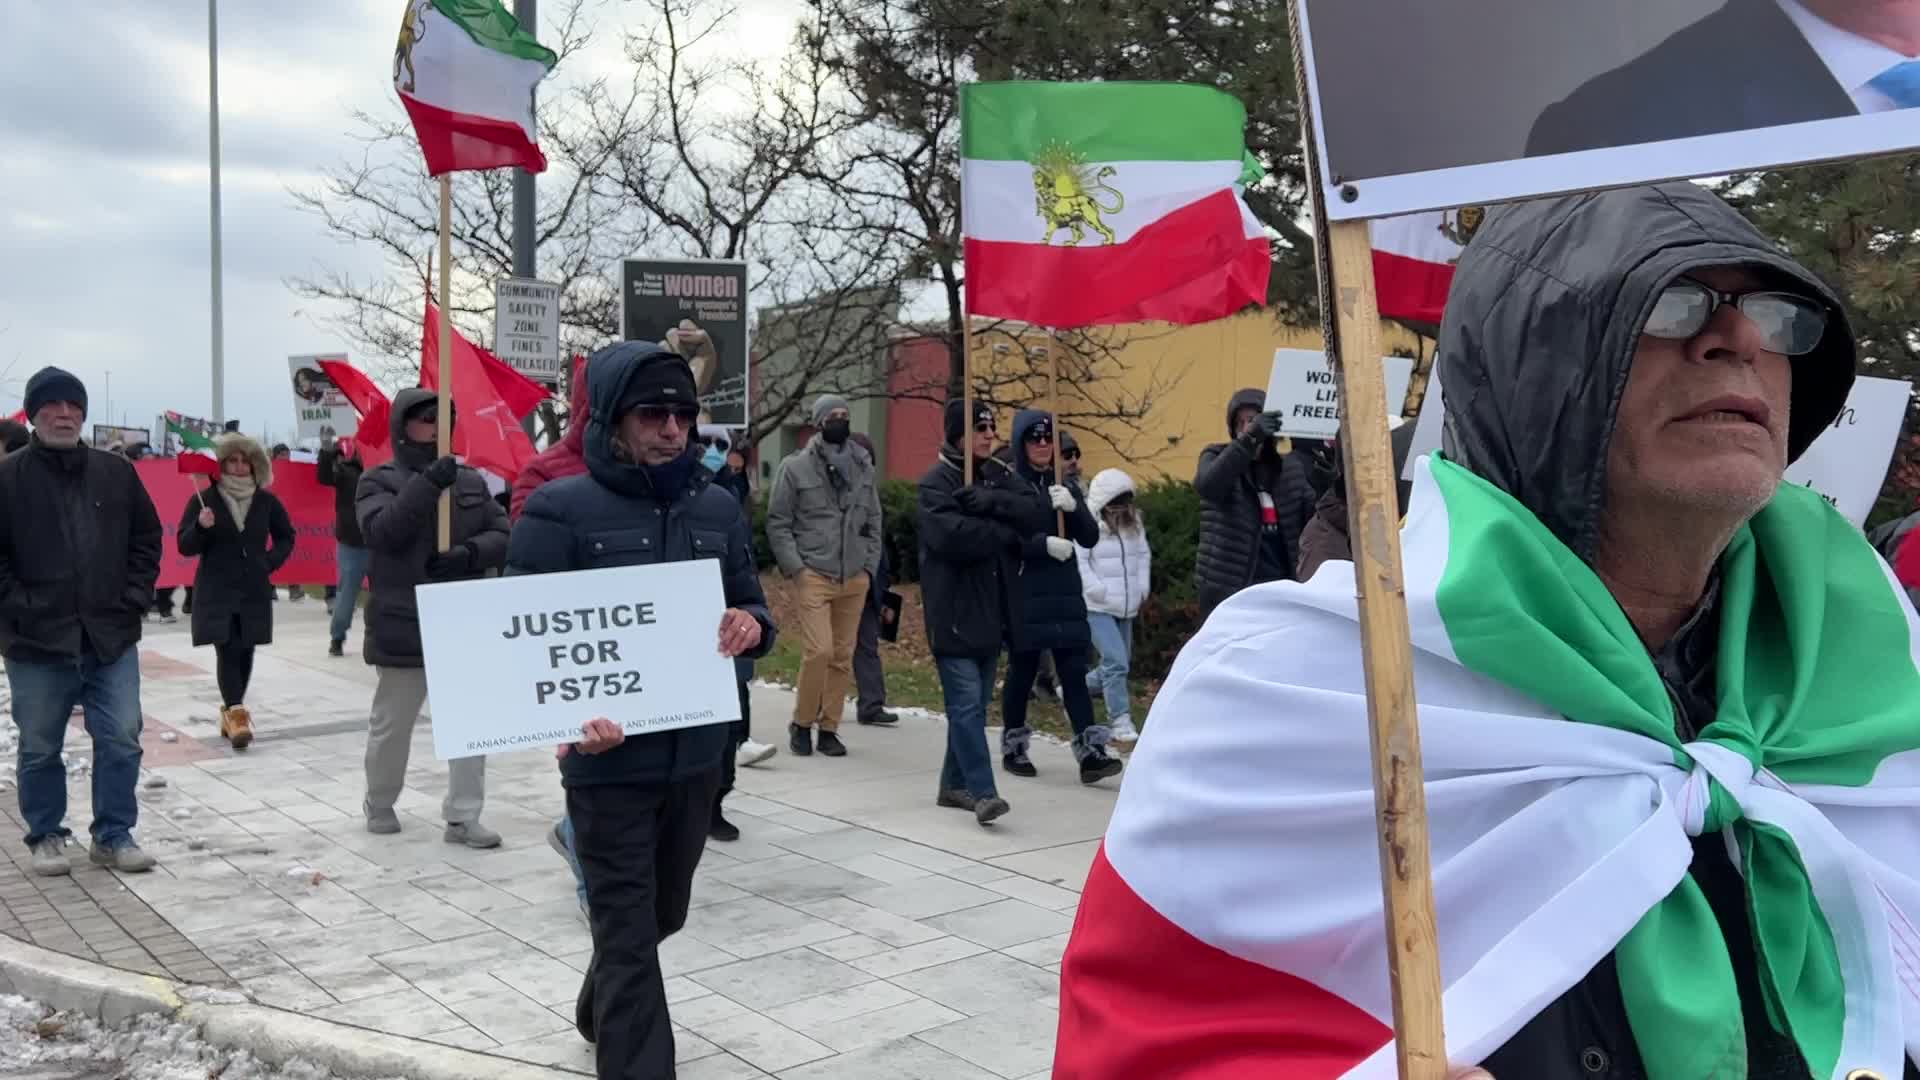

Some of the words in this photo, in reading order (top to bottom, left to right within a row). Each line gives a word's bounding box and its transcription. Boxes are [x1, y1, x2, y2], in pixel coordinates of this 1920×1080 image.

[499, 284, 557, 299] COMMUNITY
[664, 274, 738, 297] women
[508, 302, 546, 317] SAFETY
[513, 320, 540, 333] ZONE
[512, 340, 542, 353] FINES
[302, 408, 331, 421] IRAN
[502, 602, 656, 639] JUSTICE
[548, 640, 621, 668] FOR
[535, 671, 643, 704] PS752
[466, 729, 566, 751] IRANIAN-CANADIANS
[626, 718, 646, 730] AND
[648, 713, 682, 727] HUMAN
[684, 709, 715, 722] RIGHTS
